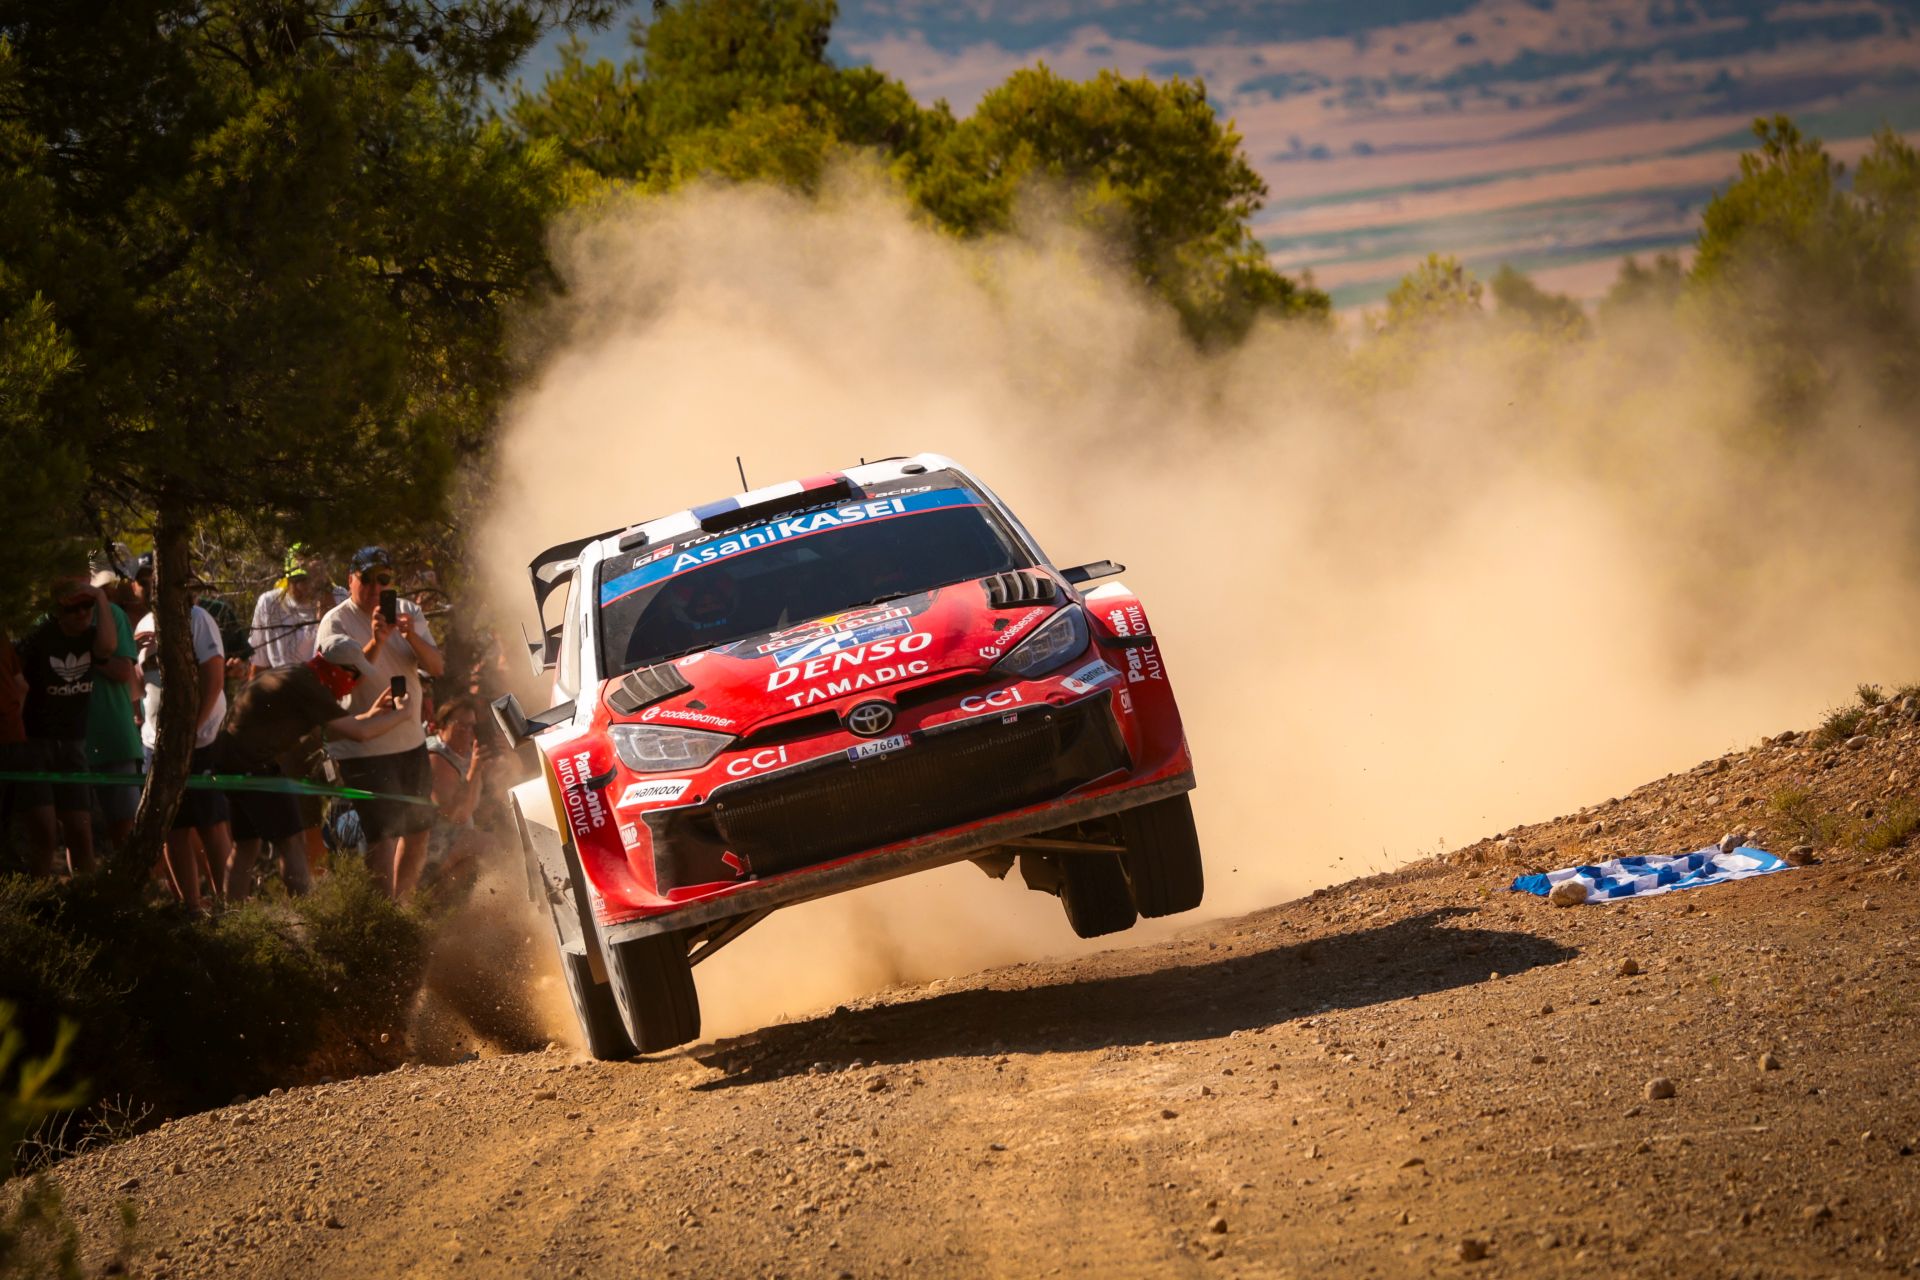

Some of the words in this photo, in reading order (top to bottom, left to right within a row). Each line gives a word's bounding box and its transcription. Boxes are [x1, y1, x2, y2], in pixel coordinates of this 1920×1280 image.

[680, 518, 768, 549] TOYOTA
[756, 625, 835, 654] Red
[837, 606, 911, 632] Bull
[766, 632, 933, 692] DENSO
[786, 660, 929, 707] TAMADIC
[660, 709, 734, 728] codebeamer
[861, 737, 900, 756] A-7664
